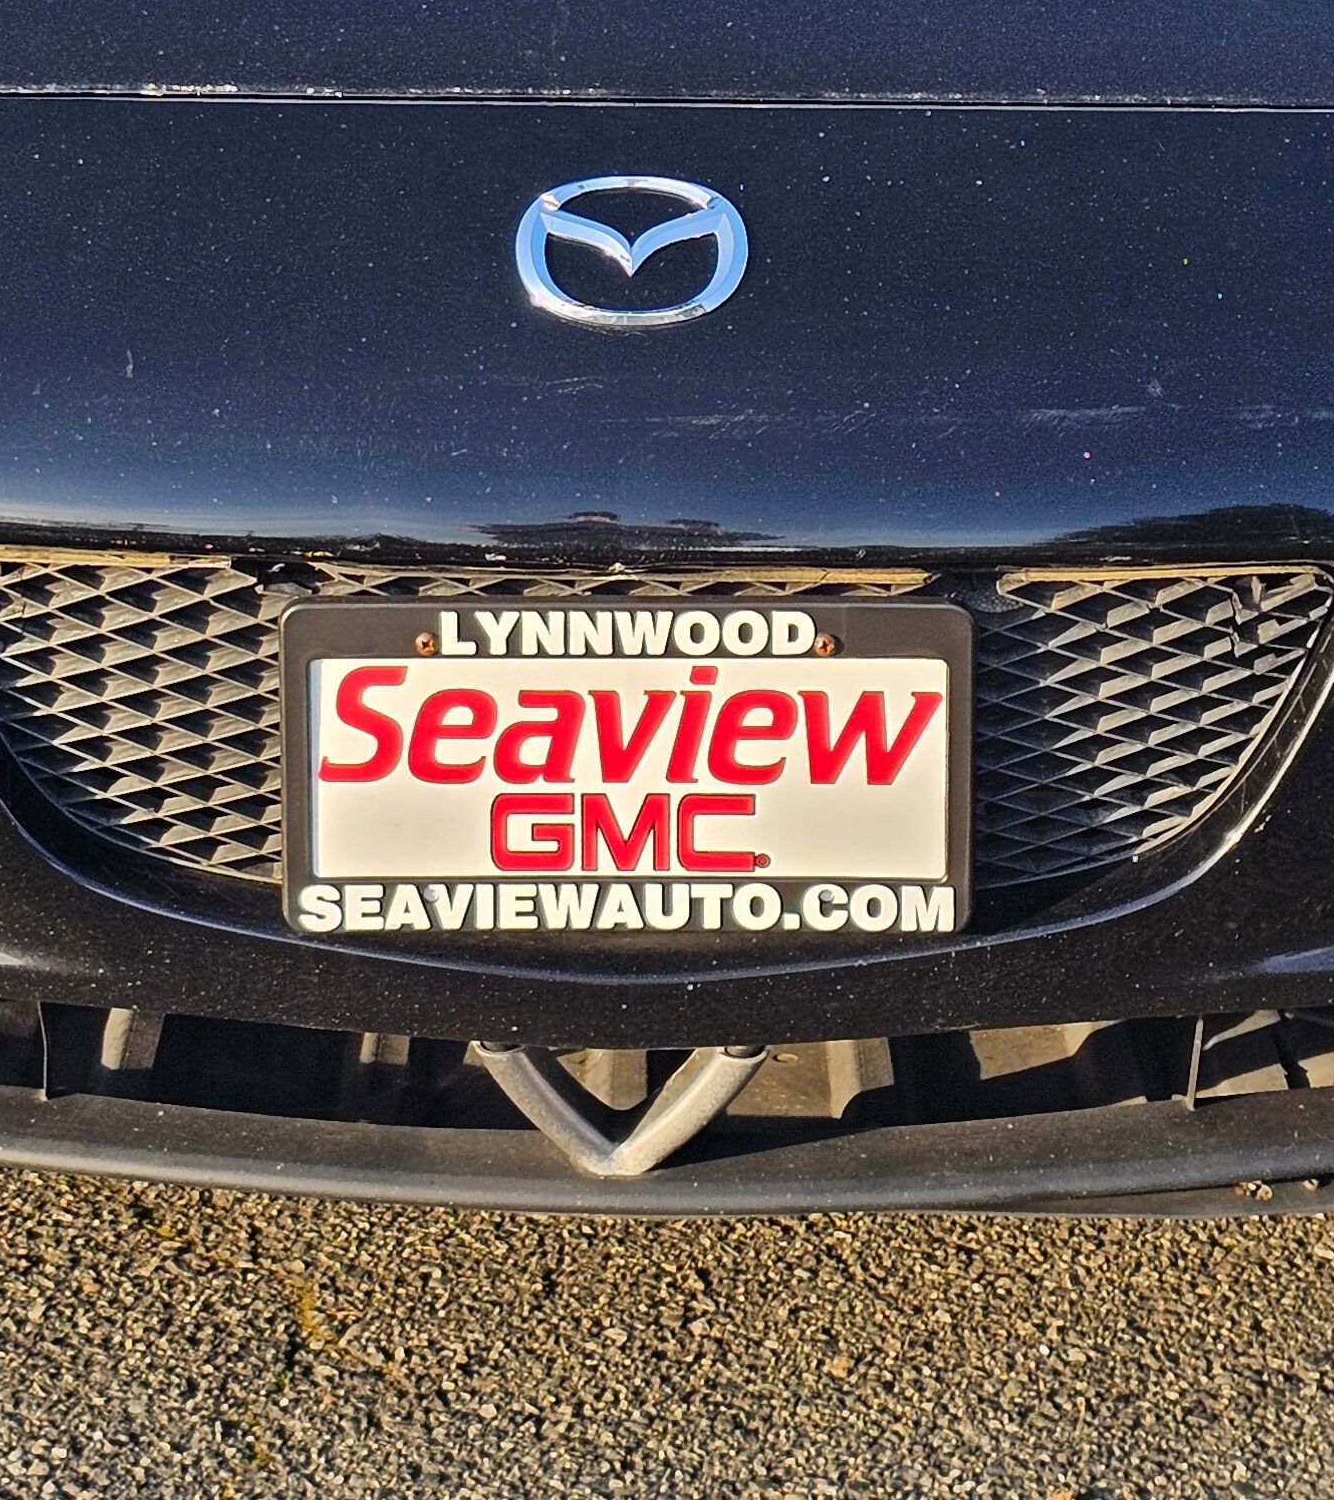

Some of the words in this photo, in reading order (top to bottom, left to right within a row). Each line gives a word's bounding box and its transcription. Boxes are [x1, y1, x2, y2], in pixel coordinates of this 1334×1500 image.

[439, 610, 818, 656] LYNNWOOD
[318, 665, 943, 786] Seaview
[491, 793, 757, 872] GMC
[298, 883, 957, 933] SEAVIEWAUTO.COM
